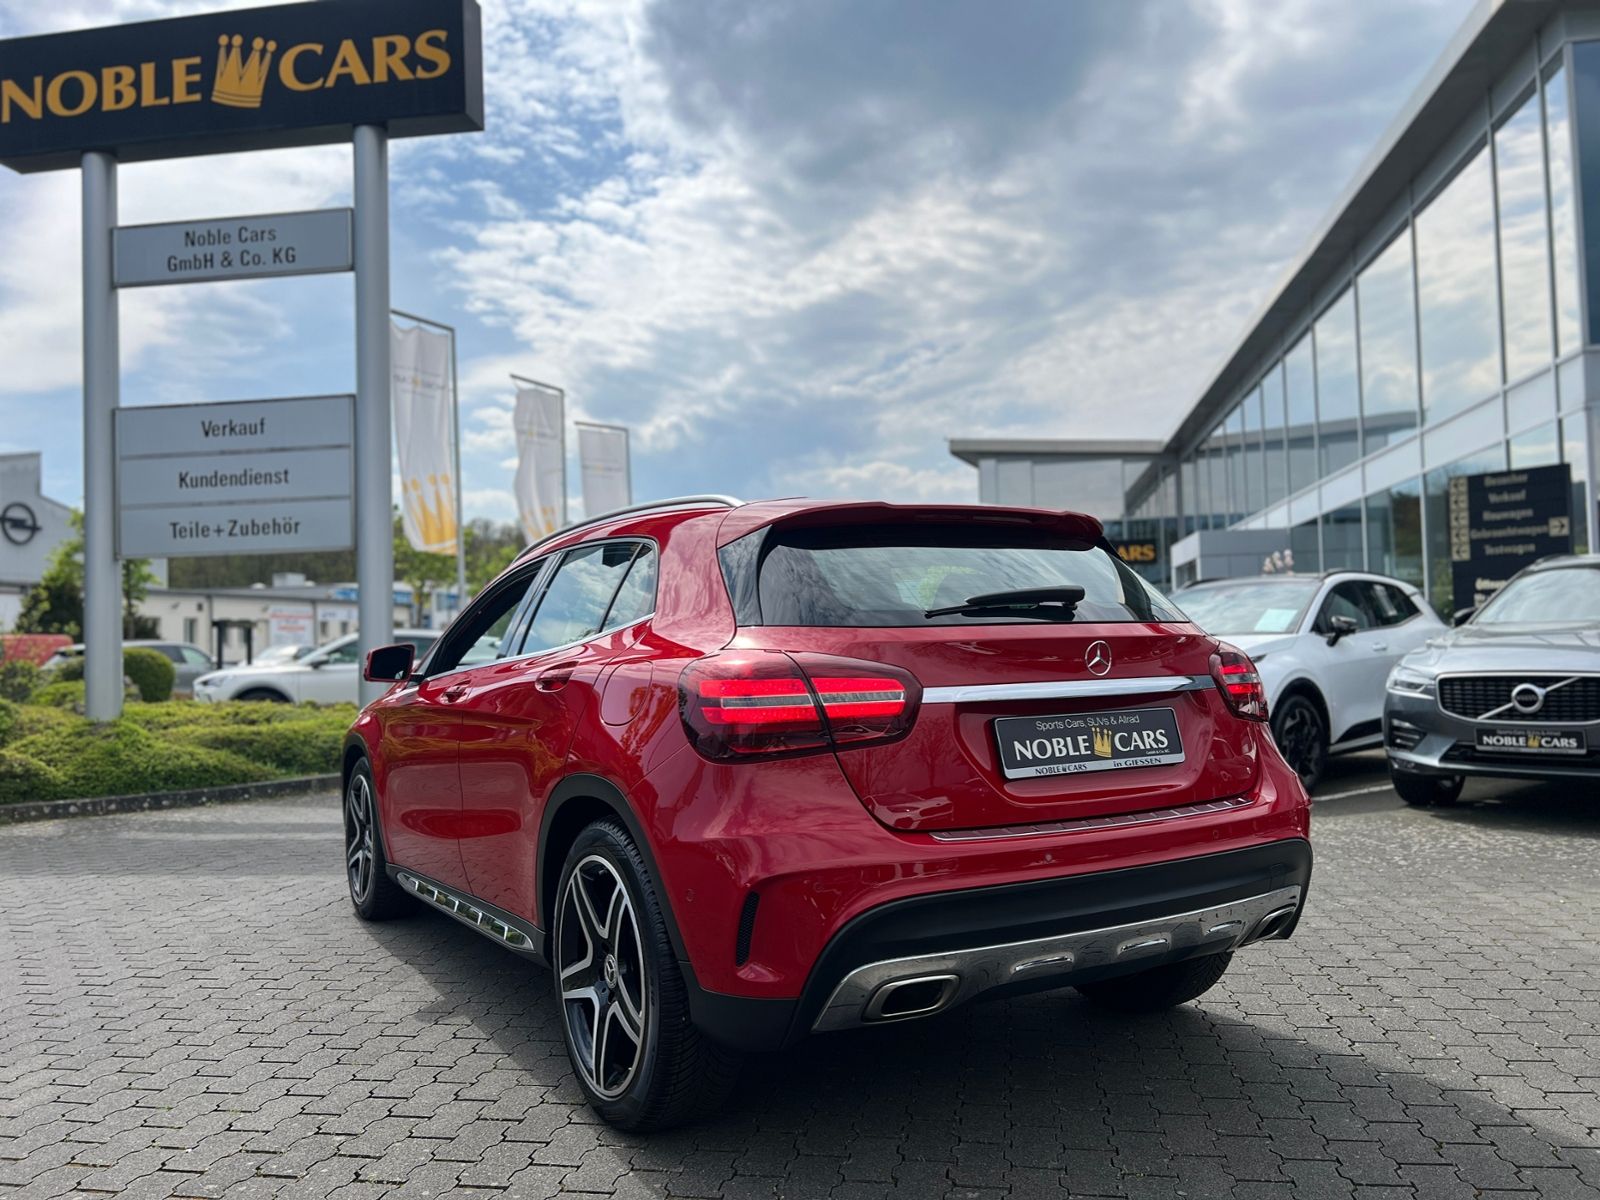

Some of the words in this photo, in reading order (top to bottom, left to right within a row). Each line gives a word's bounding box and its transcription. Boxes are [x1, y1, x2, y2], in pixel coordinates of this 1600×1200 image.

[1, 56, 202, 123] NOBLE
[279, 29, 451, 91] CARS
[184, 229, 231, 247] Noble
[238, 226, 277, 243] Cars
[167, 253, 214, 272] GmbH
[220, 251, 234, 268] &
[240, 250, 266, 266] Co.
[272, 247, 296, 264] KG
[201, 417, 266, 437] Verkauf
[178, 468, 289, 489] Kundendienst
[170, 517, 301, 539] Teile+Zubehör
[1117, 544, 1155, 561] ARS
[1036, 719, 1064, 731] Sports
[1110, 716, 1117, 725] &
[1013, 735, 1091, 761] NOBLE
[1114, 728, 1169, 751] CARS
[1482, 735, 1527, 747] NOBLE
[1541, 737, 1577, 748] CARS
[1035, 765, 1062, 775] NOBLE
[1067, 763, 1087, 773] CARS
[1124, 758, 1161, 767] GIESSEN
